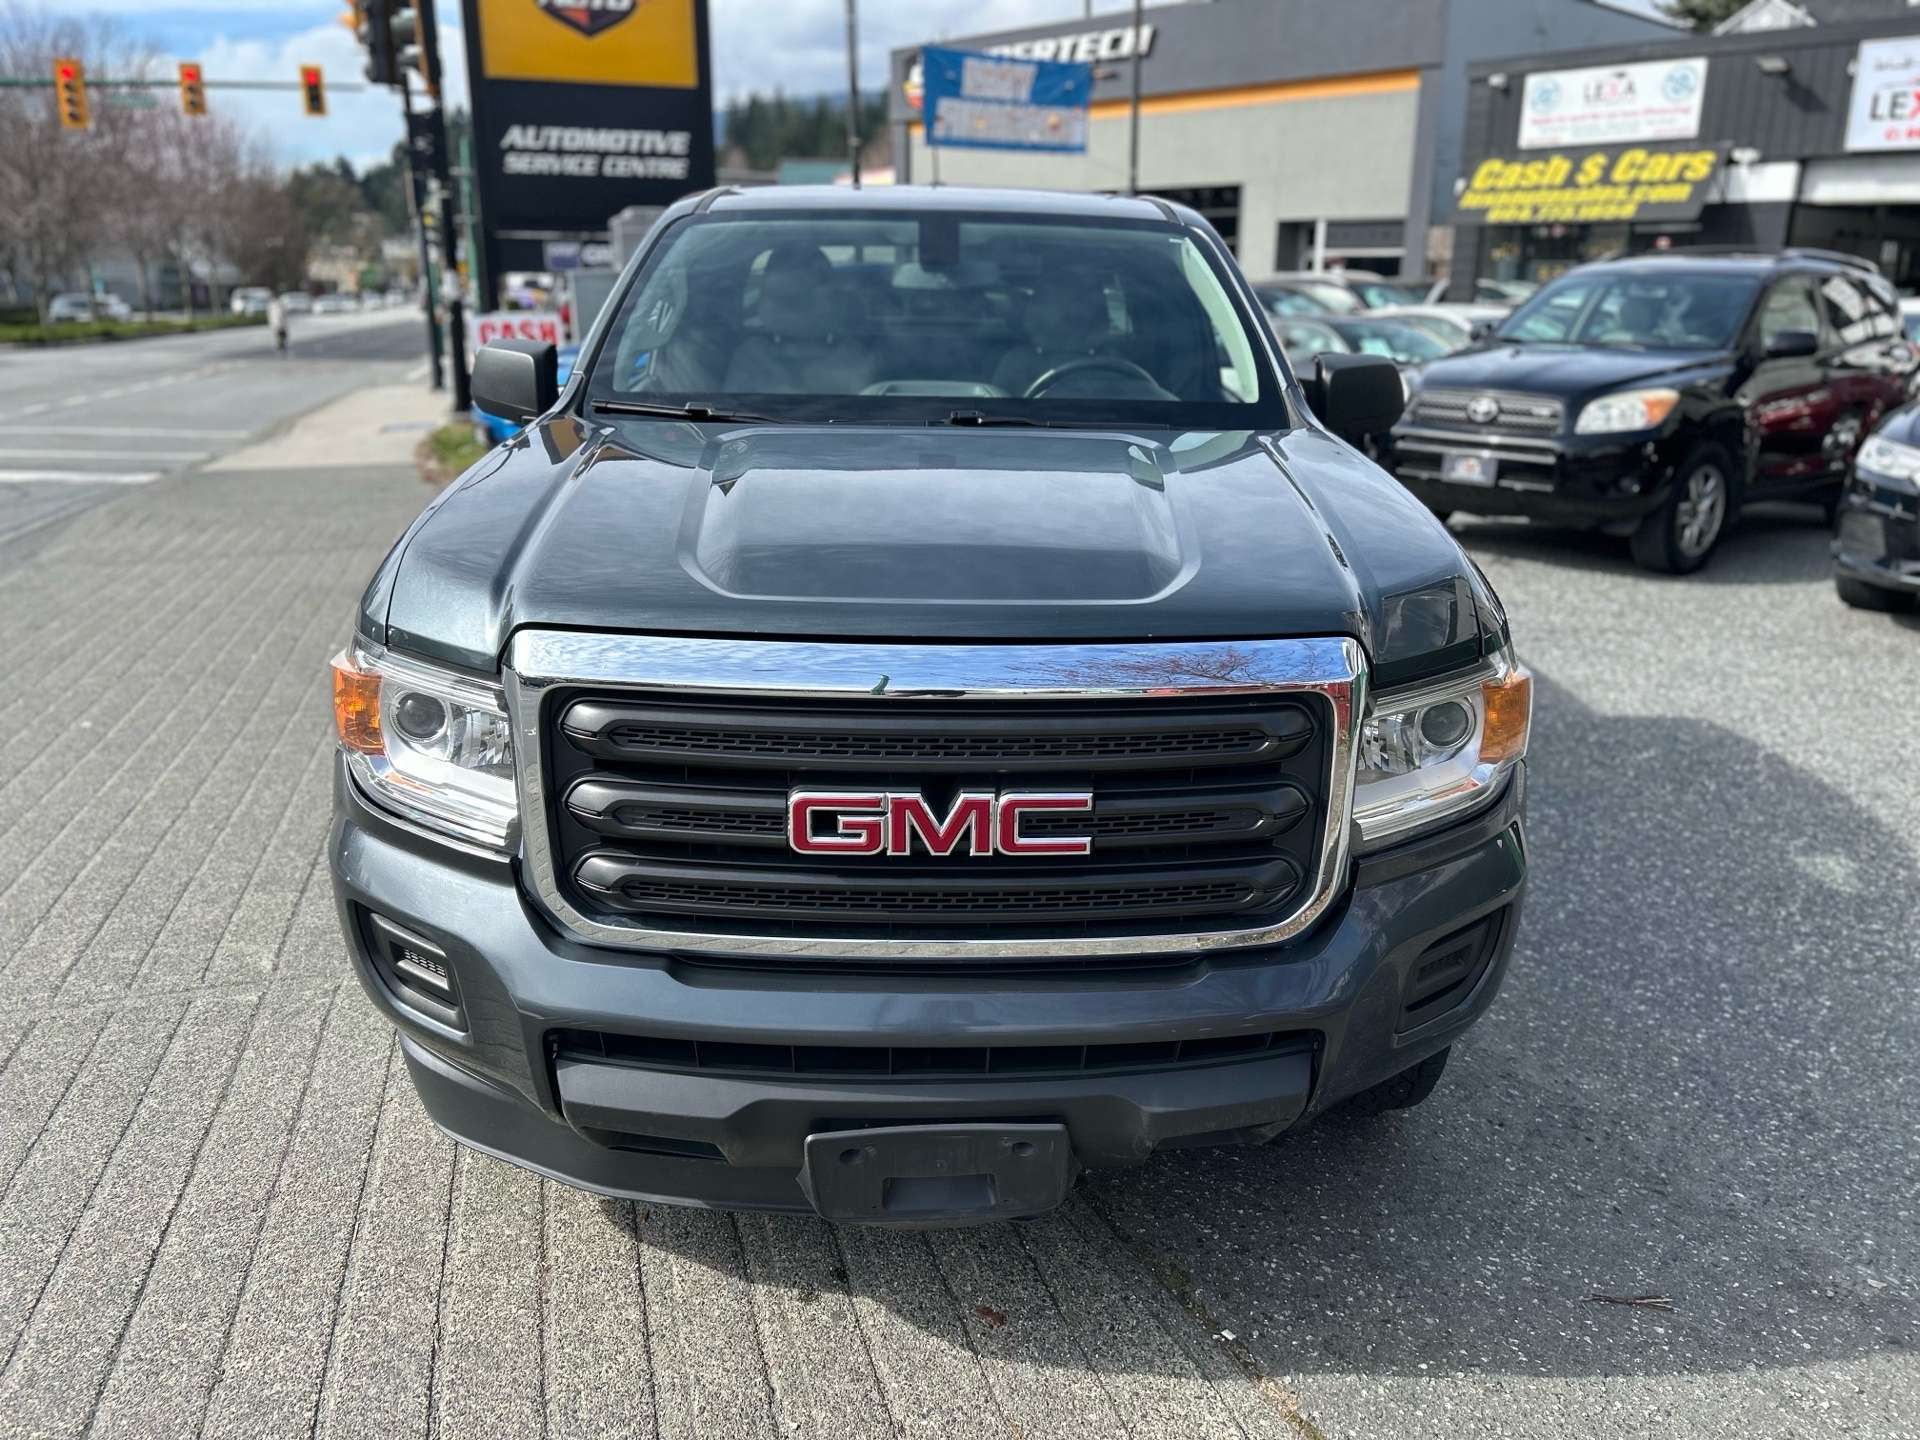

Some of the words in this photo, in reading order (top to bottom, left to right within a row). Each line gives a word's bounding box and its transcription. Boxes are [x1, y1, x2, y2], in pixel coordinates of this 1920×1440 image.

[500, 123, 691, 155] AUTOMOTIVE
[503, 151, 600, 177] SERVICE
[602, 154, 690, 179] CENTRE
[1470, 157, 1572, 191] Cash
[1610, 147, 1717, 183] Cars
[790, 790, 1094, 857] GMC
